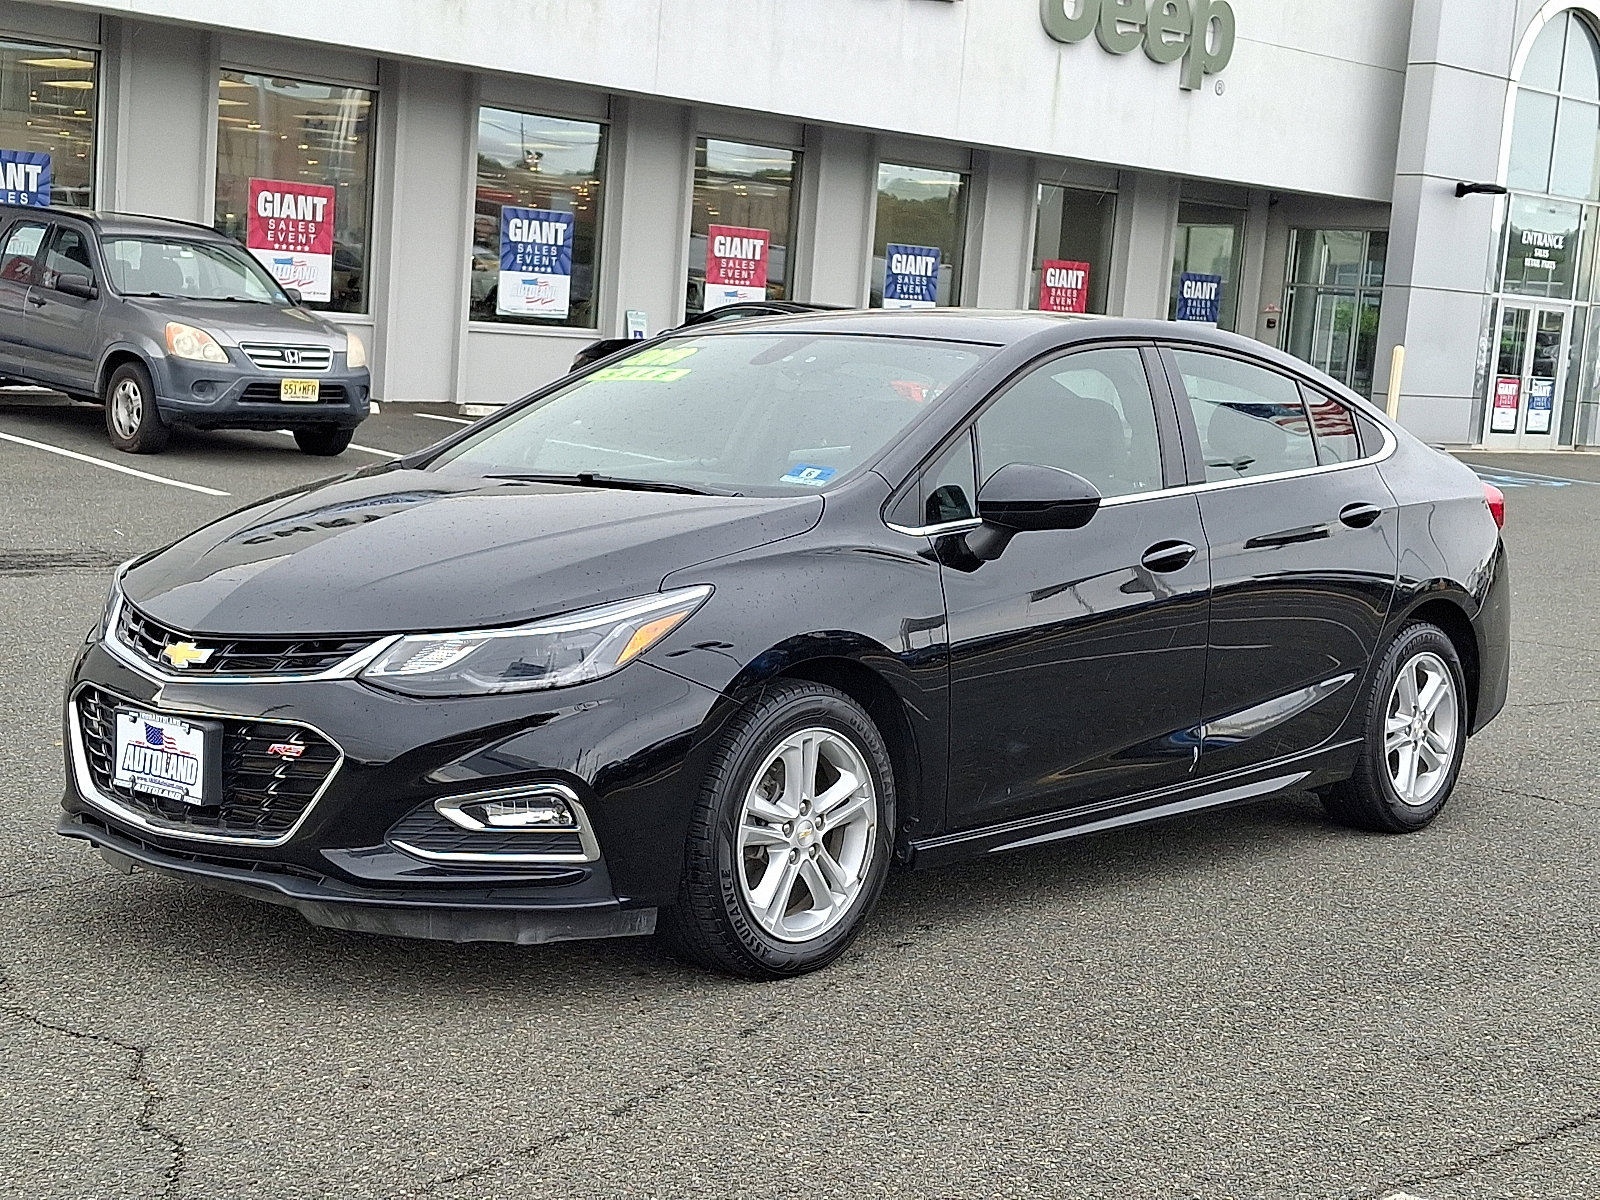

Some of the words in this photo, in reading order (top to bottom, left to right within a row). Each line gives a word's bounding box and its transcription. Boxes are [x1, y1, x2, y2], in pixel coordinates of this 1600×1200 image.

[257, 191, 328, 222] GIANT
[268, 219, 316, 233] SALES
[508, 218, 568, 246] GIANT
[267, 231, 317, 245] EVENT
[1521, 231, 1565, 250] ENTRANCE
[517, 244, 558, 256] SALES
[713, 236, 764, 260] GIANT
[516, 255, 558, 266] EVENT
[720, 259, 756, 269] SALES
[891, 254, 936, 277] GIANT
[719, 269, 756, 279] EVENT
[897, 276, 928, 286] SALES
[1046, 268, 1085, 290] GIANT
[896, 284, 928, 295] EVENT
[1051, 288, 1078, 298] SALES
[1183, 281, 1218, 301] GIANT
[1050, 297, 1077, 306] EVENT
[267, 743, 306, 757] RS
[122, 743, 199, 787] AUTOLAND
[720, 869, 773, 959] ASSURANCE
